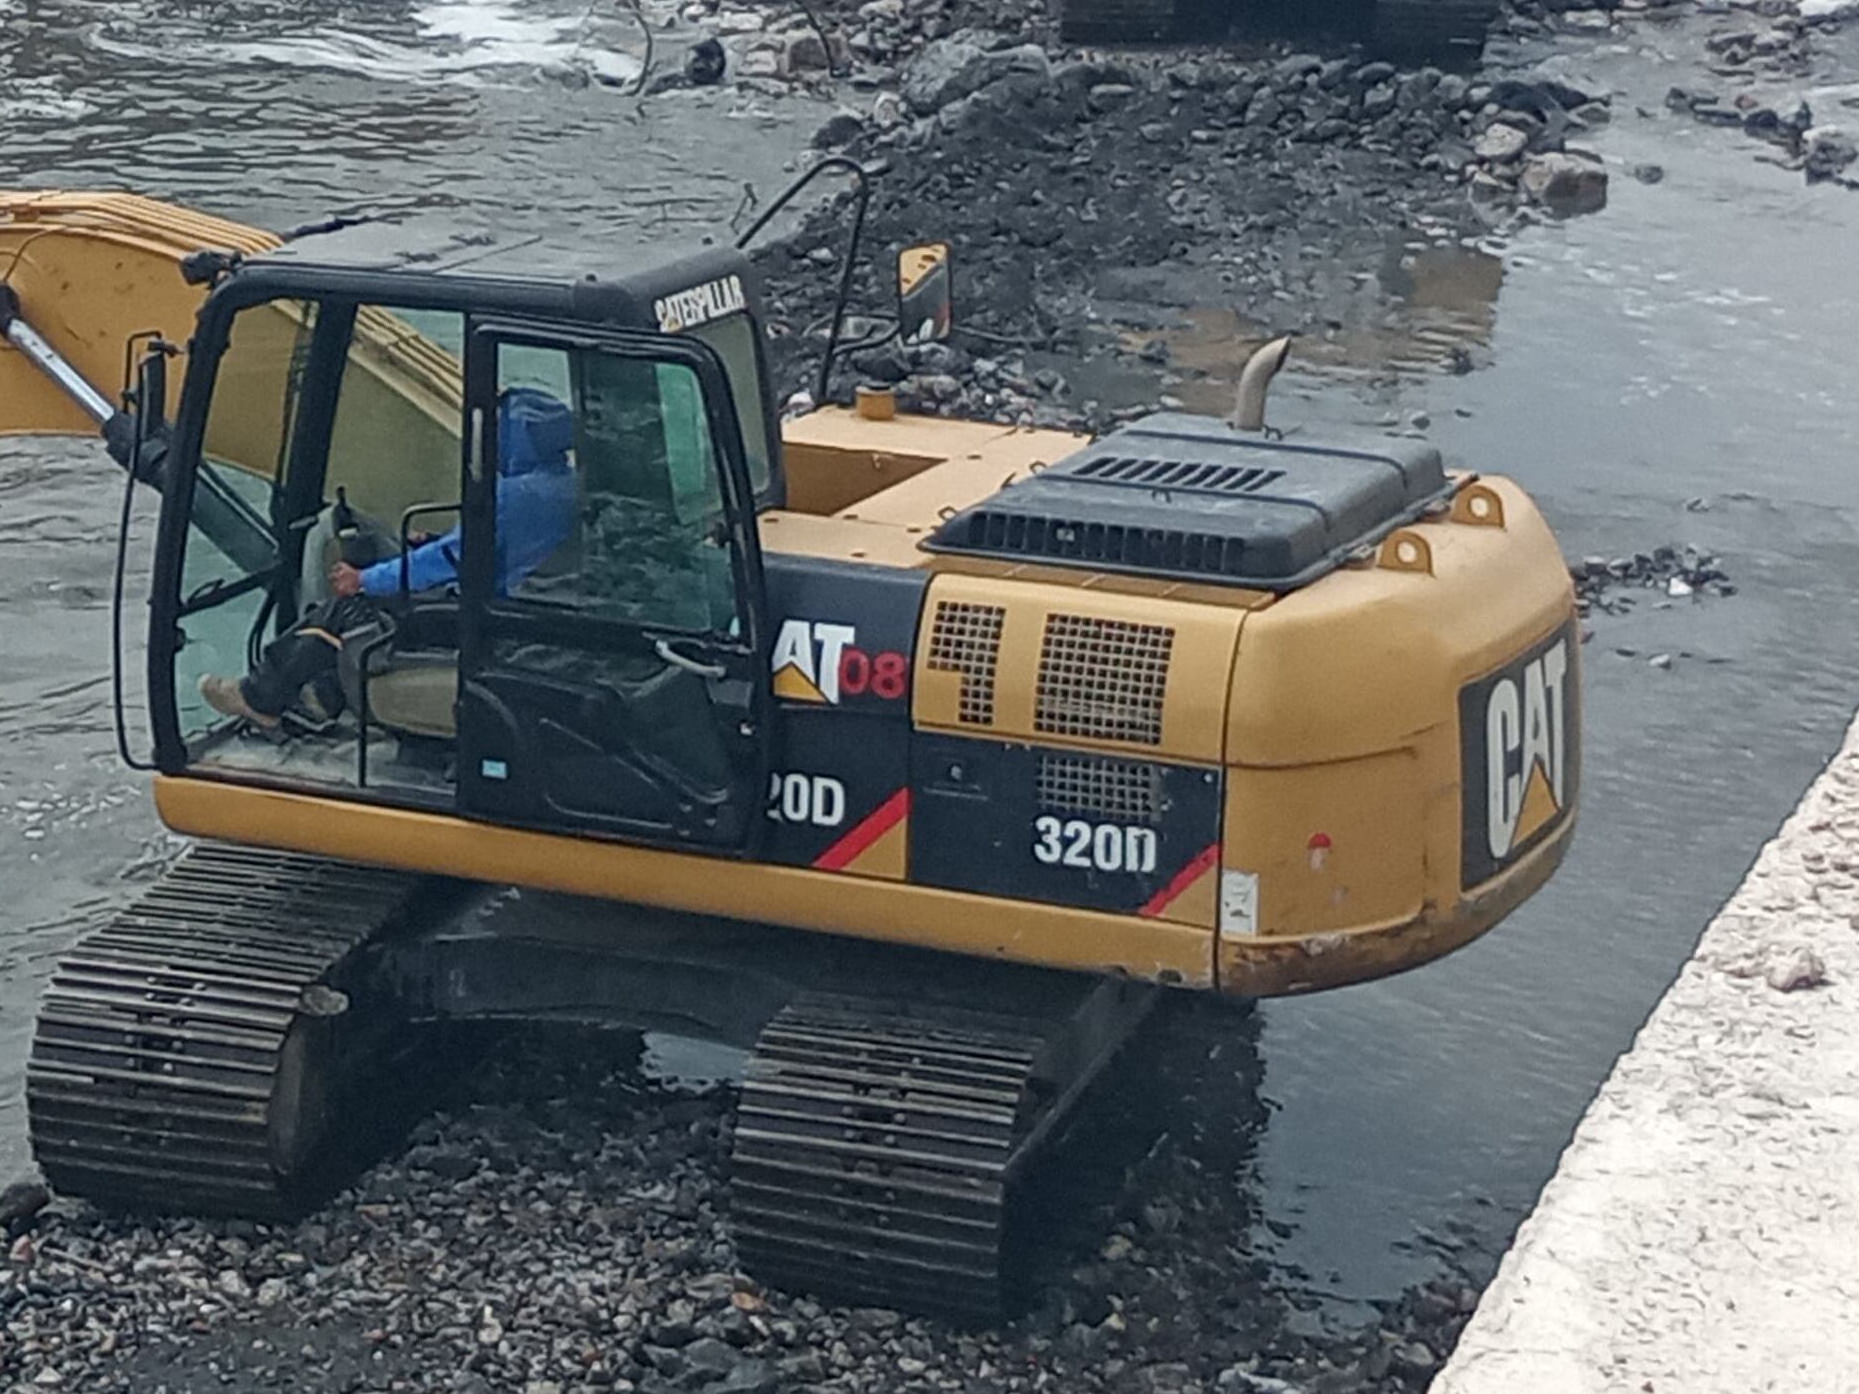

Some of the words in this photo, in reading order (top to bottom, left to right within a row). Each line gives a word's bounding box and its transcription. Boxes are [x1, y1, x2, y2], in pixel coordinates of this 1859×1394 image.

[654, 275, 746, 334] CATERPILLAR
[838, 648, 907, 700] 08
[1487, 637, 1567, 859] CAT
[1033, 815, 1157, 873] 320D
